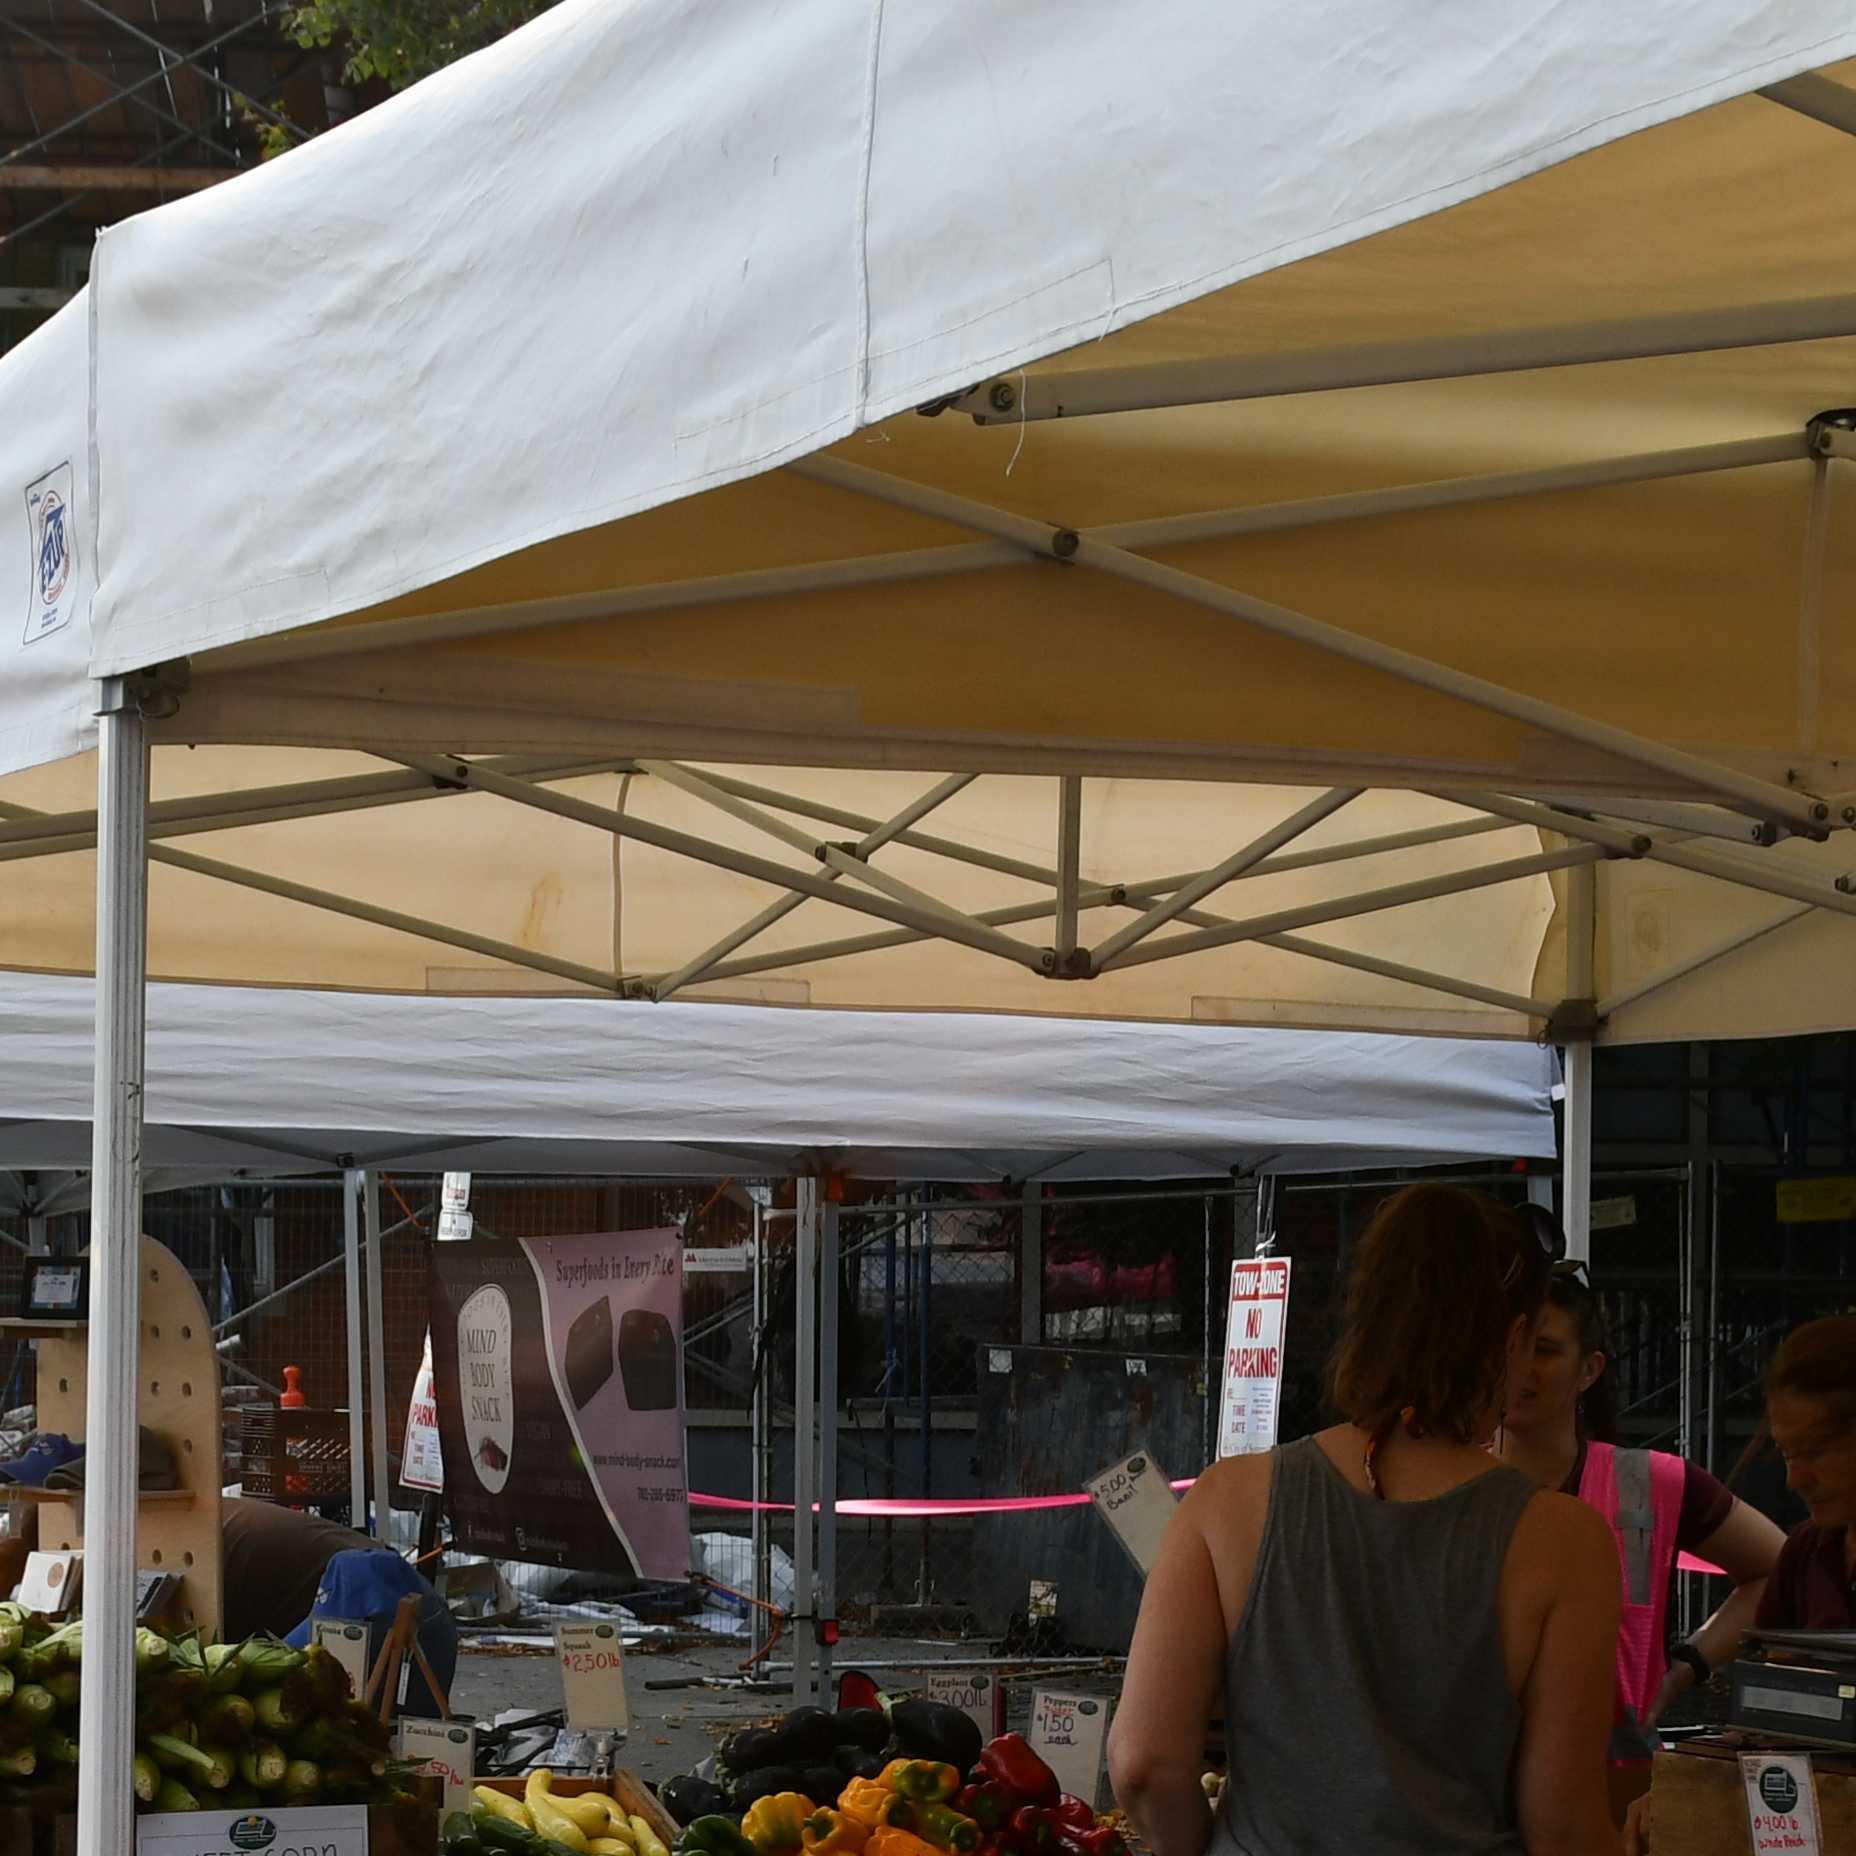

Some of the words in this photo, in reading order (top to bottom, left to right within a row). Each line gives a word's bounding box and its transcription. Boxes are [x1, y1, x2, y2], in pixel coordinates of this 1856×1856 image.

[556, 1258, 609, 1289] Superfoods
[611, 1256, 622, 1280] in
[1245, 1307, 1263, 1340] NO
[465, 1330, 497, 1354] MIND
[470, 1362, 496, 1388] BODY
[1227, 1346, 1278, 1378] PARKING
[471, 1397, 502, 1423] SNACK
[929, 1677, 969, 1689] Eggplant
